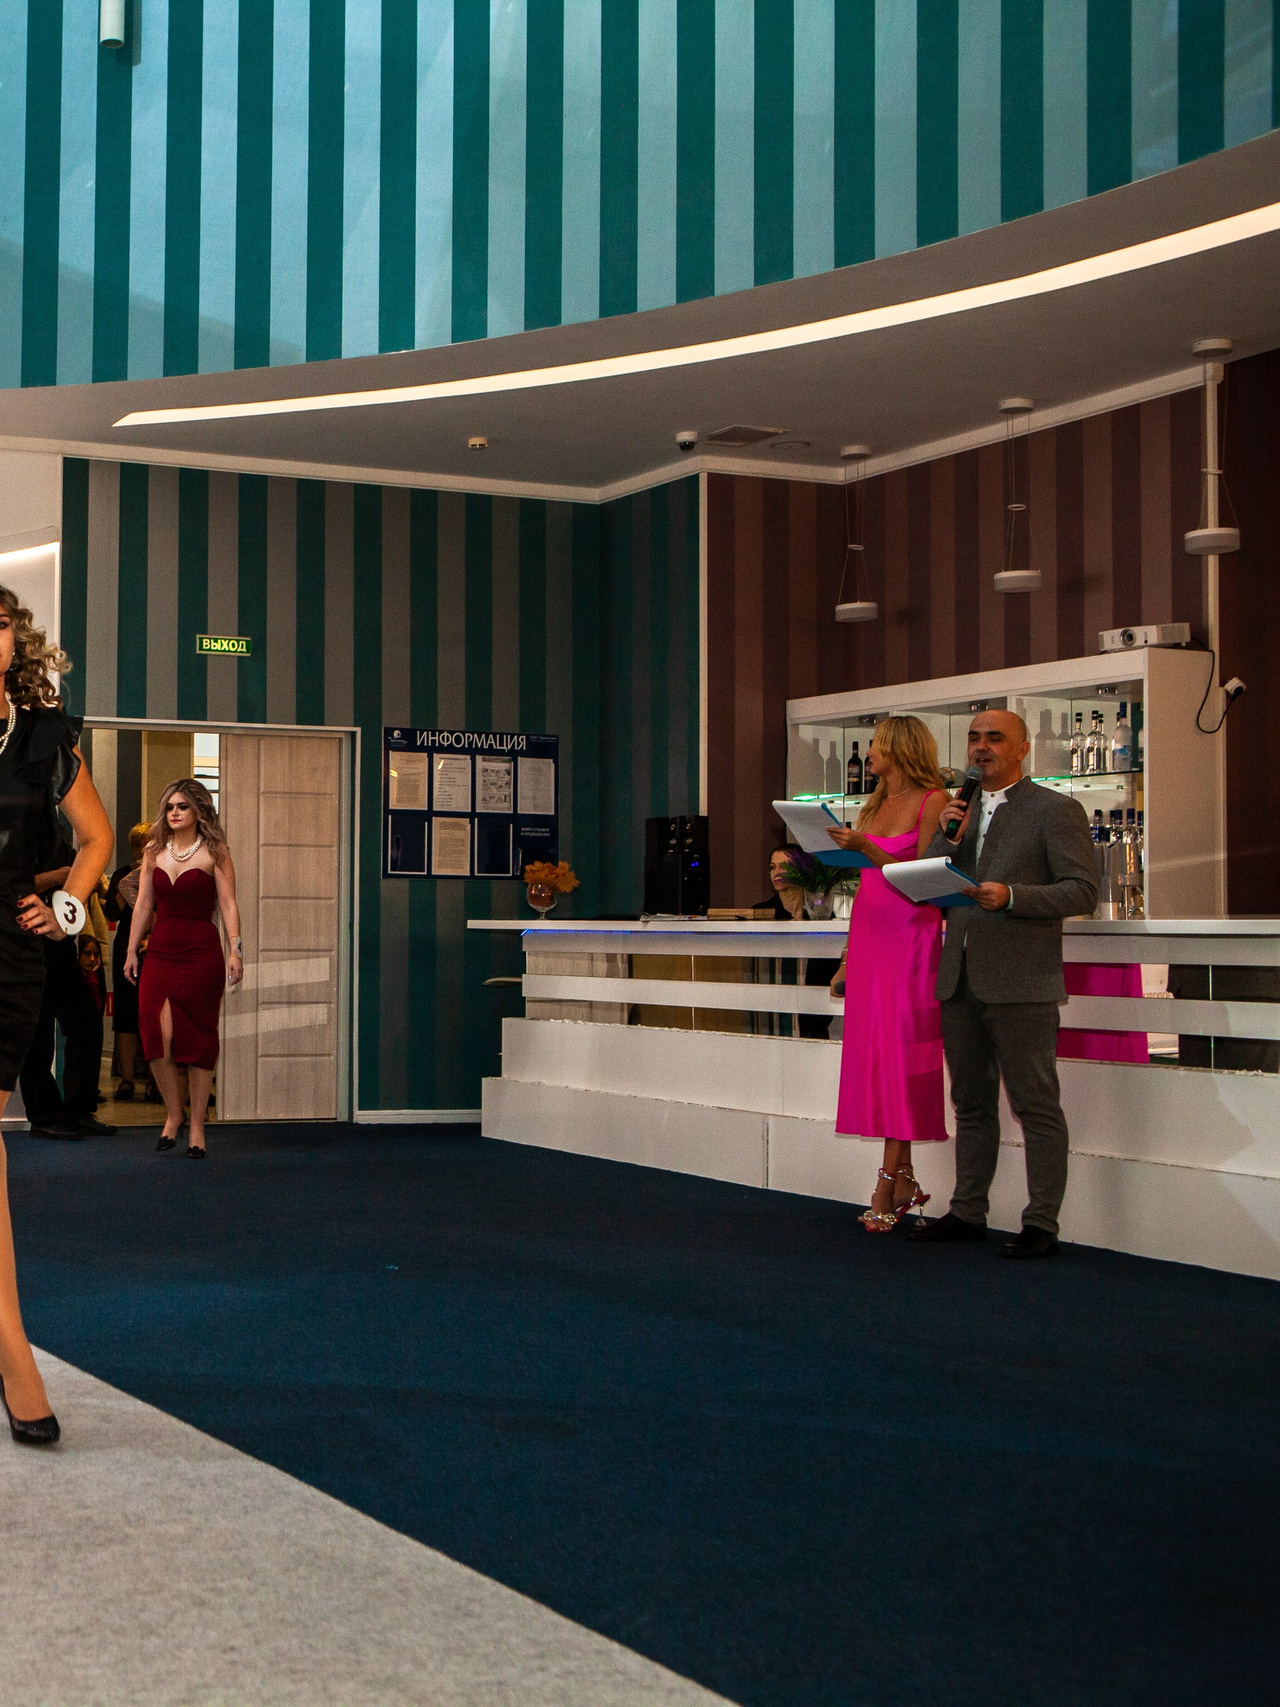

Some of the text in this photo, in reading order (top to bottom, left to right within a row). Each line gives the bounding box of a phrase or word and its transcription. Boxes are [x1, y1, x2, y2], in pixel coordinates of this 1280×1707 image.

[202, 638, 247, 653] ВЫХОД
[416, 730, 527, 753] ИНФОРМАЦИЯ
[63, 901, 78, 925] 3
